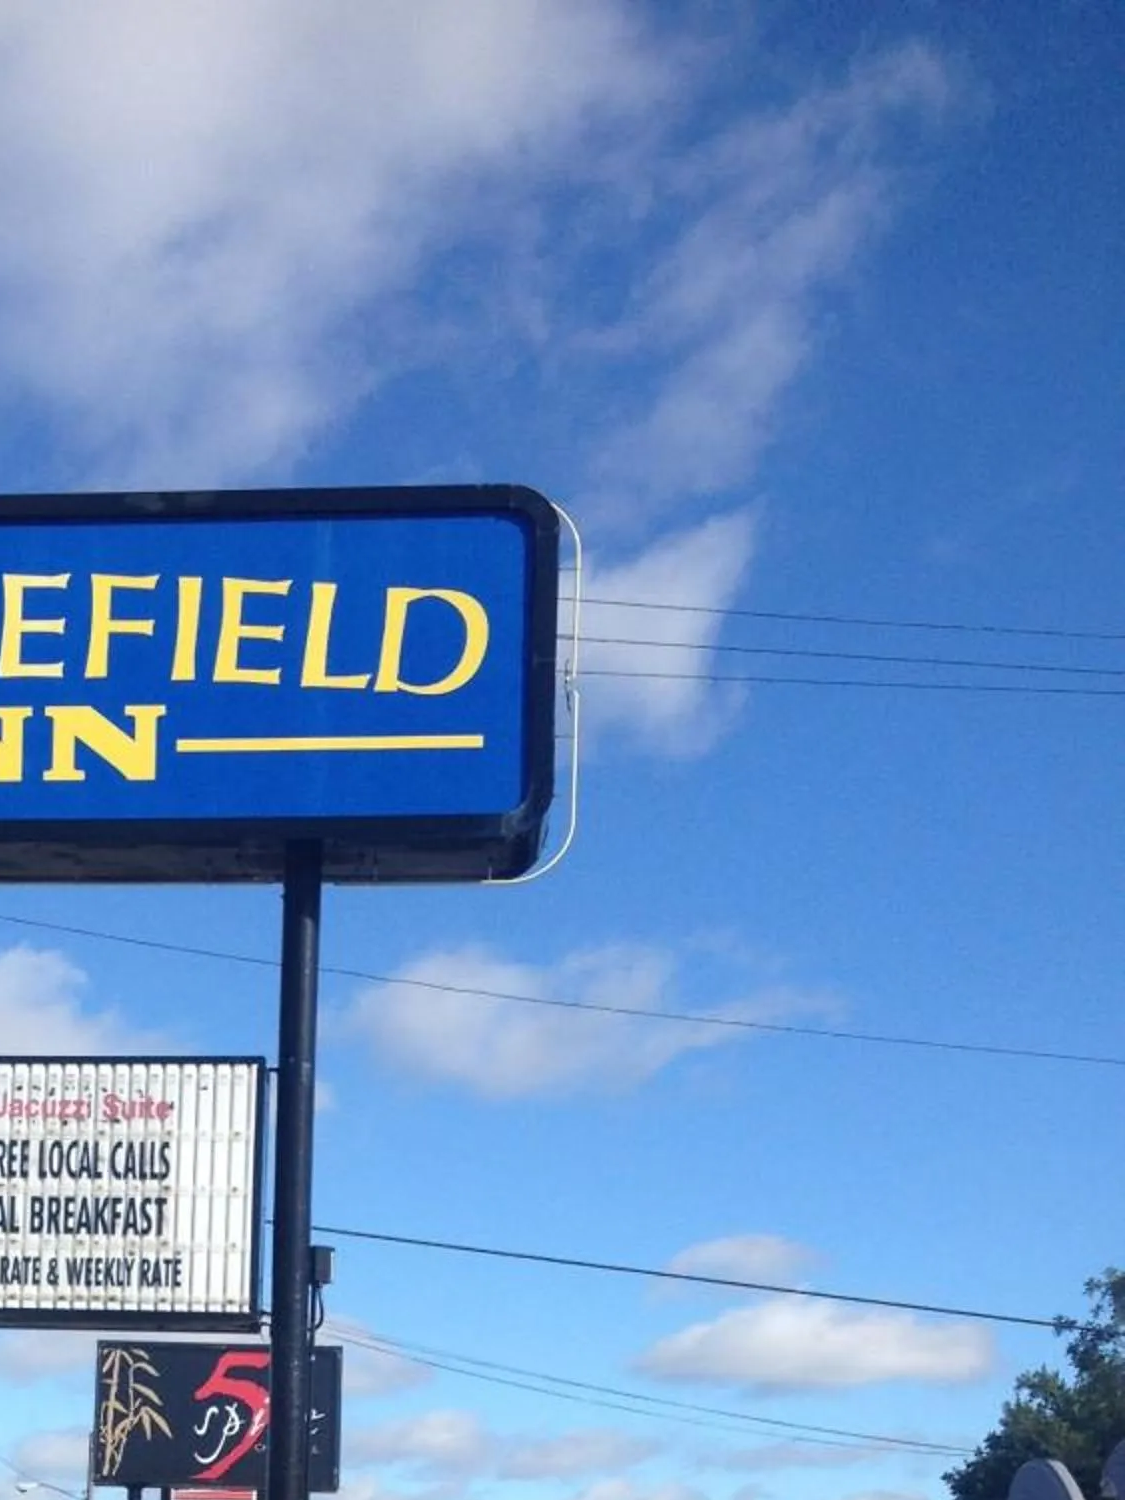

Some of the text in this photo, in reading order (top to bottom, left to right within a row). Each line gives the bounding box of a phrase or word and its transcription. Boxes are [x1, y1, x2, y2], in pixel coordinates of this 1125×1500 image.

[38, 1140, 103, 1180] LOCAL
[110, 1141, 171, 1181] CALLS
[30, 1196, 167, 1236] BREAKFAST
[0, 1256, 41, 1286] RATE
[46, 1257, 59, 1286] &
[66, 1257, 135, 1287] WEEKLY
[139, 1258, 182, 1288] RATE
